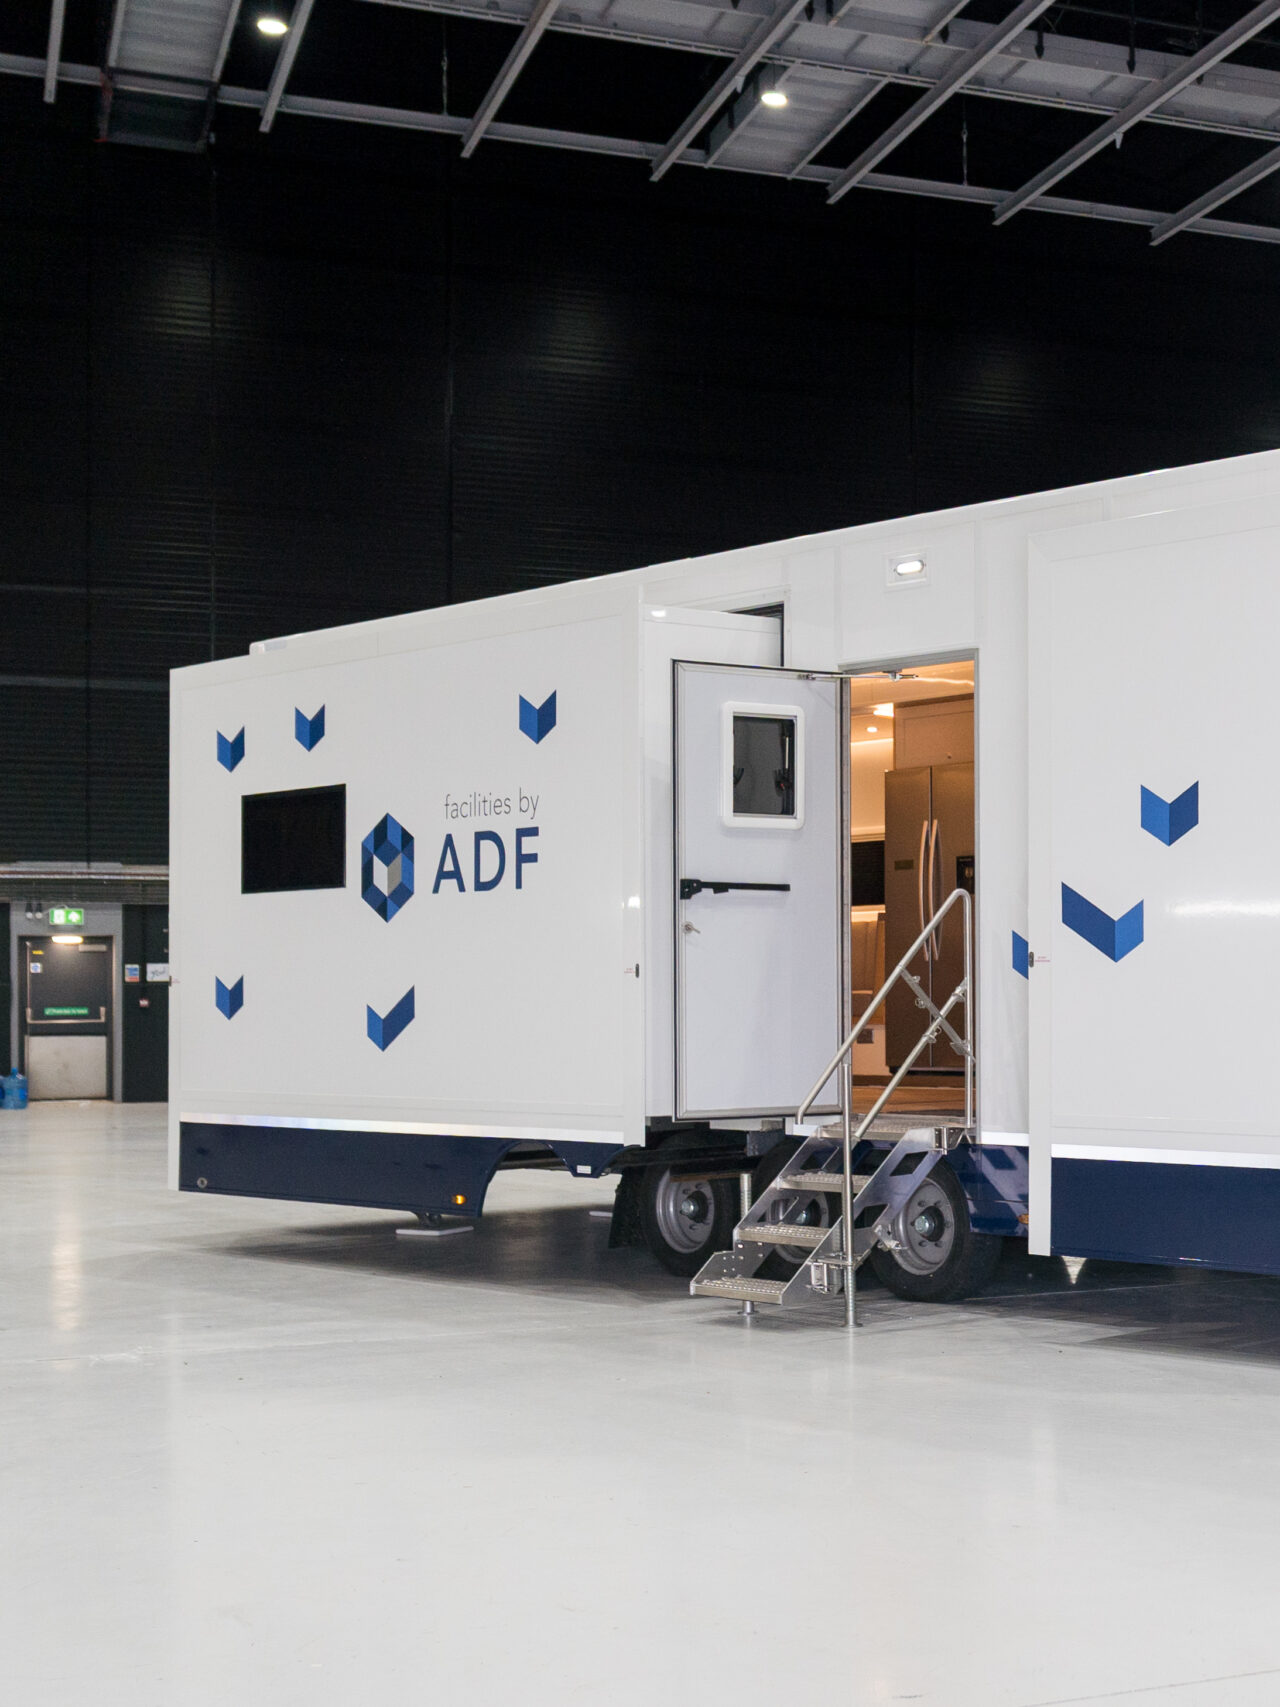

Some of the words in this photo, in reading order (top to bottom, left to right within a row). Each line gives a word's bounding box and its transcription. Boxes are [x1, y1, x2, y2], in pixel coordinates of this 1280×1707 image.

[444, 792, 512, 820] facilities
[519, 787, 540, 820] by
[432, 826, 540, 894] ADF
